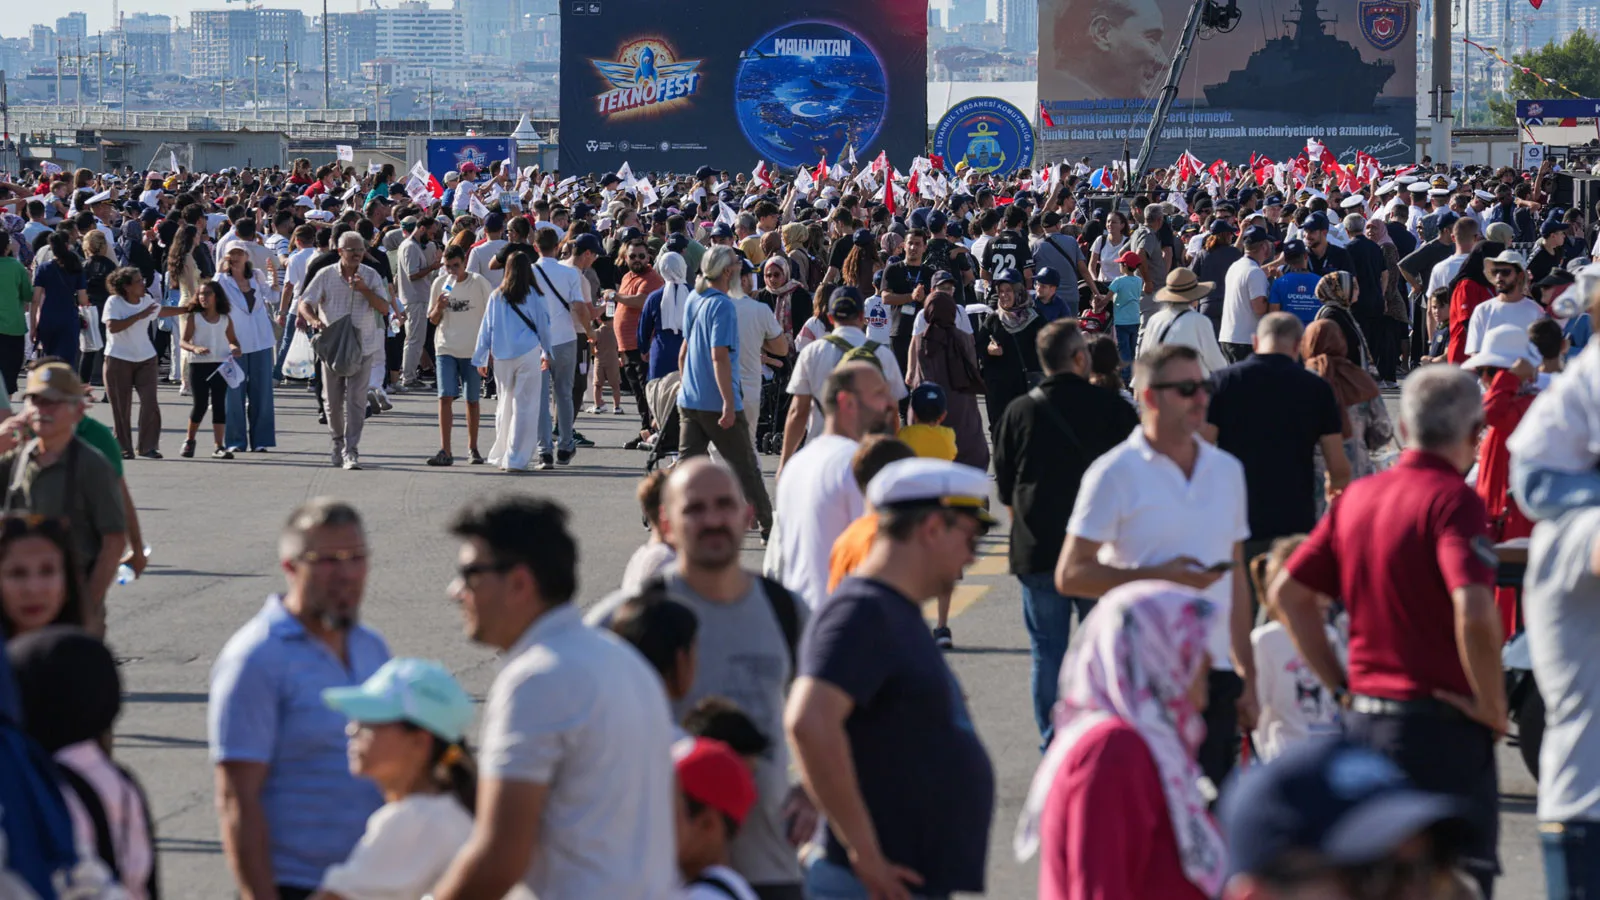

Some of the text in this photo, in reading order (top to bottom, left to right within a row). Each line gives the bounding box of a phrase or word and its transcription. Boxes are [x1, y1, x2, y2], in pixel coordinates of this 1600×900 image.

[807, 39, 851, 57] VATAN
[597, 72, 699, 114] TEKNOFEST
[936, 100, 1031, 148] İSTANBUL TERSANESİ KOMUTANLIĞI
[1040, 128, 1070, 141] Çünkü
[1071, 128, 1095, 140] daha
[1096, 127, 1114, 141] çok
[1115, 129, 1128, 139] ve
[1128, 127, 1147, 139] dah
[1184, 126, 1208, 138] işler
[1208, 126, 1247, 139] yapmak
[1248, 124, 1325, 138] mecburiyetinde
[1326, 126, 1338, 137] ve
[992, 253, 1016, 280] 22
